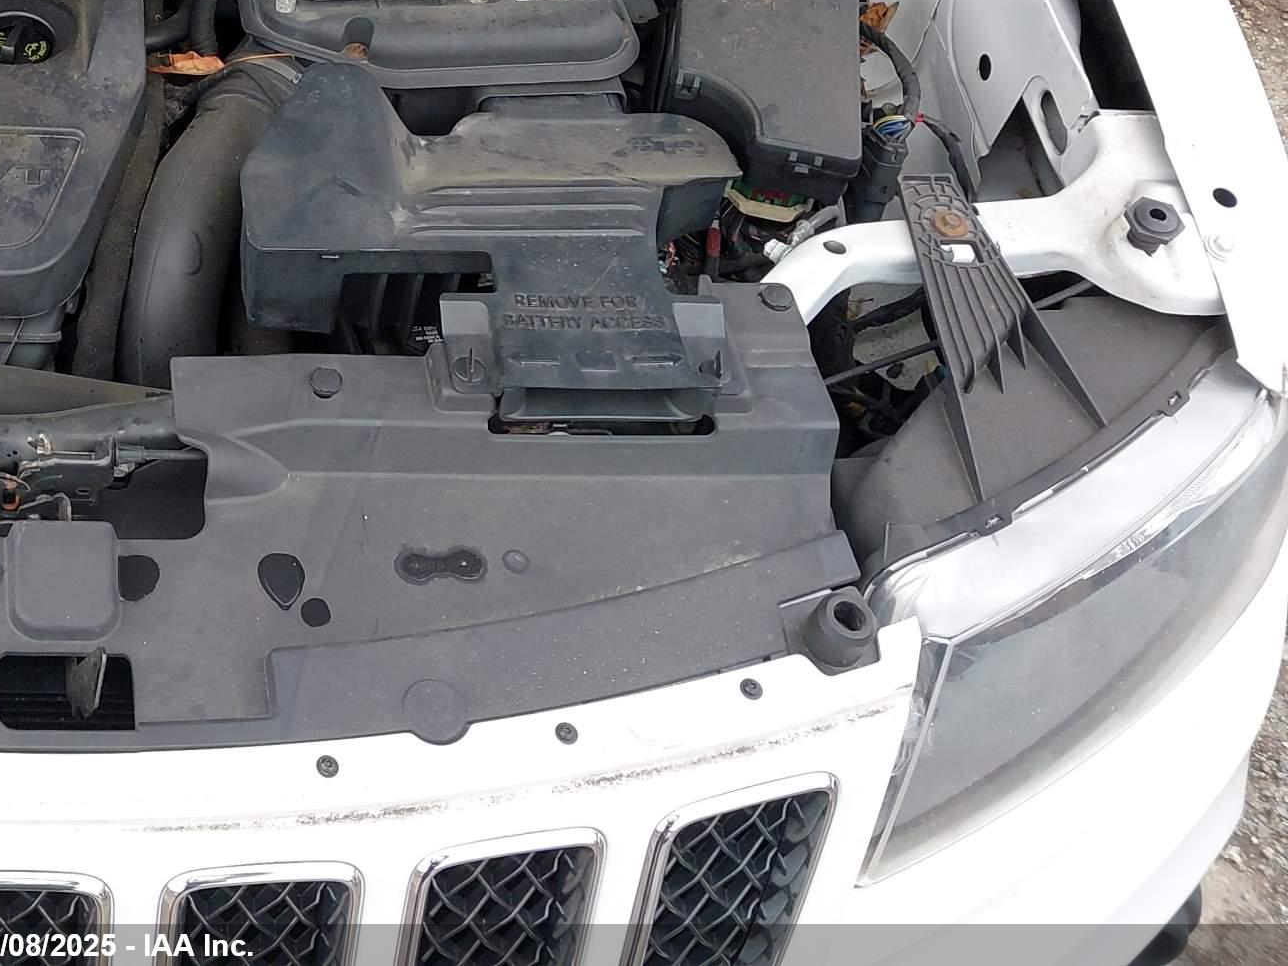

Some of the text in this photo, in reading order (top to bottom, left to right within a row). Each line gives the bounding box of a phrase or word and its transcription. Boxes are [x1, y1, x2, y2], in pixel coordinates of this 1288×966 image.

[513, 294, 638, 310] REMOVE FOR
[503, 313, 666, 330] BATTERY ACCESS
